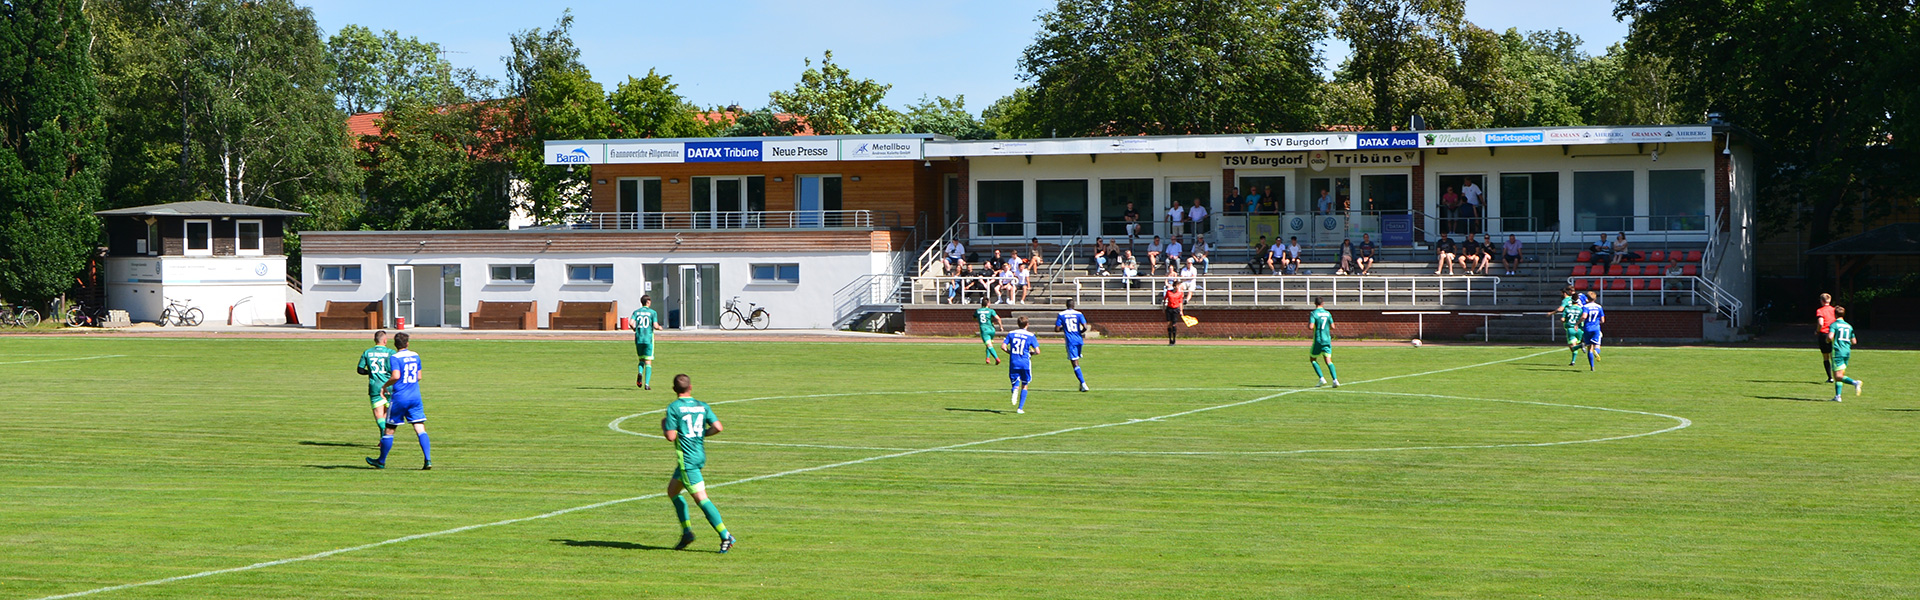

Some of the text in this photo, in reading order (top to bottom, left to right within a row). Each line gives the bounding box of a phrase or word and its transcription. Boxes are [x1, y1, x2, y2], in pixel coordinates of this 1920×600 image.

[1264, 138, 1329, 148] TSV Burgdorf
[1359, 137, 1416, 147] DATAX Arena
[1487, 133, 1541, 142] Marktspiegel
[687, 147, 759, 158] DATAX Tribüne
[772, 146, 828, 157] Neue Presse
[872, 143, 911, 151] Metallbau
[556, 153, 585, 163] Baran
[649, 149, 679, 158] Allgemeine
[1334, 153, 1402, 164] Tribüne
[1224, 155, 1303, 167] TSV Burgdorf
[980, 314, 987, 324] 8
[1588, 310, 1599, 322] 17
[637, 316, 650, 329] 20
[1065, 317, 1079, 332] 16
[1321, 317, 1328, 330] 7
[1838, 328, 1850, 341] 11
[1012, 338, 1026, 355] 31
[370, 357, 387, 374] 31
[403, 362, 418, 383] 13
[682, 413, 704, 438] 14
